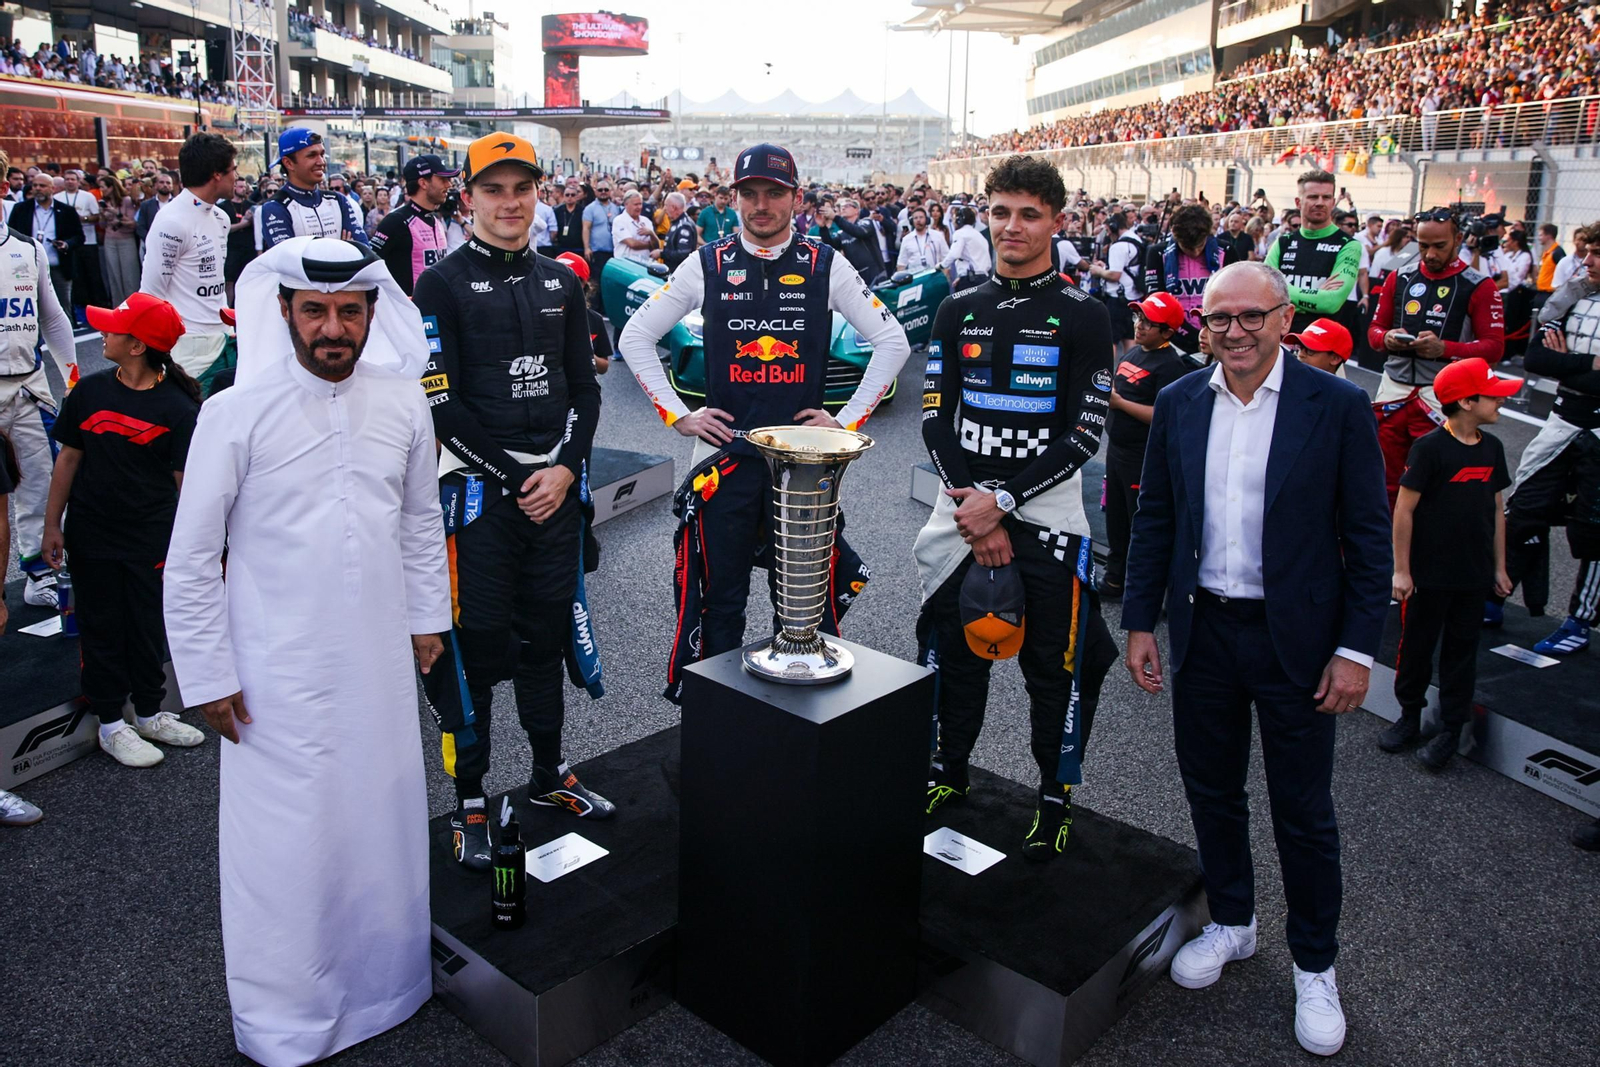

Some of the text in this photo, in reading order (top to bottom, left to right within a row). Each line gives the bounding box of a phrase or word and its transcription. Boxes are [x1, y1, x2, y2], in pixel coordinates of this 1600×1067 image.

[574, 31, 621, 39] SHOWDOWN
[743, 155, 751, 169] 1
[1316, 243, 1341, 252] KICK
[23, 323, 36, 332] App
[728, 319, 805, 331] ORACLE
[904, 315, 929, 331] ramco
[960, 327, 993, 336] Android
[729, 364, 805, 383] Red Bull
[1015, 373, 1052, 388] allwyn
[421, 377, 444, 389] WALT
[983, 395, 1052, 412] Technologies
[450, 436, 508, 481] RICHARD MILLE
[931, 449, 948, 481] RICHARD
[1022, 462, 1075, 499] RICHARD MILLE
[572, 601, 594, 656] allwyn
[987, 643, 1000, 657] 4
